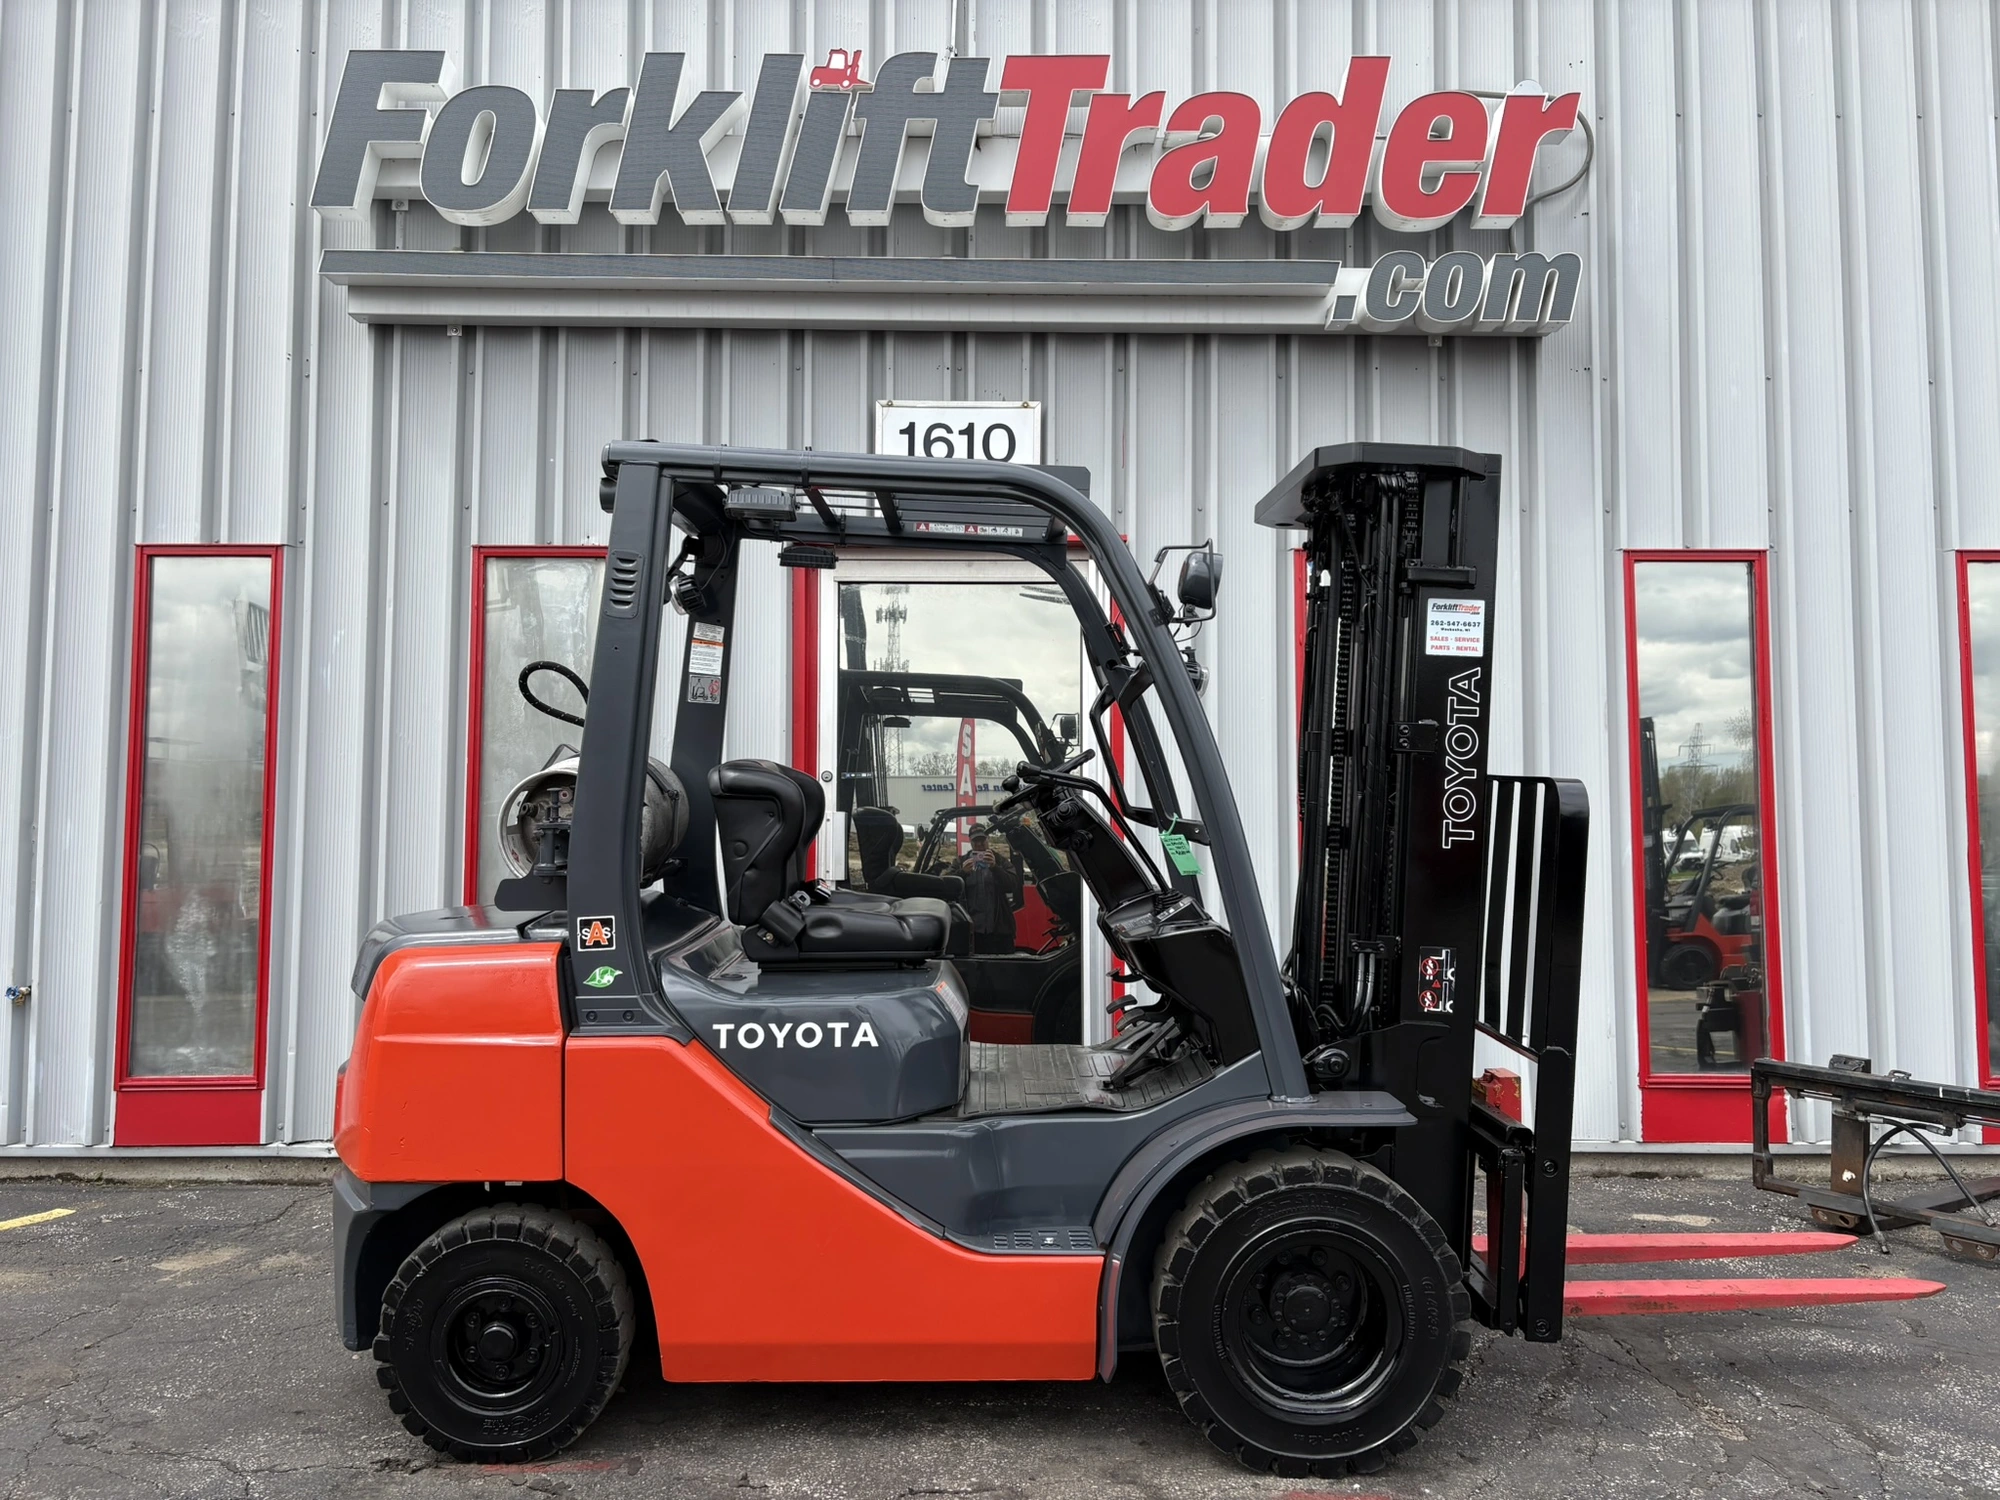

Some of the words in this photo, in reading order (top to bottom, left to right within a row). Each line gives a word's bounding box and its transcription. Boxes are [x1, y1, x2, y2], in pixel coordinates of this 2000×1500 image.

[309, 49, 1583, 228] ForkliftTrader
[1328, 249, 1583, 330] .com
[898, 421, 1016, 463] 1610
[1432, 603, 1481, 611] ForkliftTrader
[1442, 667, 1481, 849] TOYOTA
[581, 921, 612, 946] SAS
[712, 1022, 879, 1049] TOYOTA
